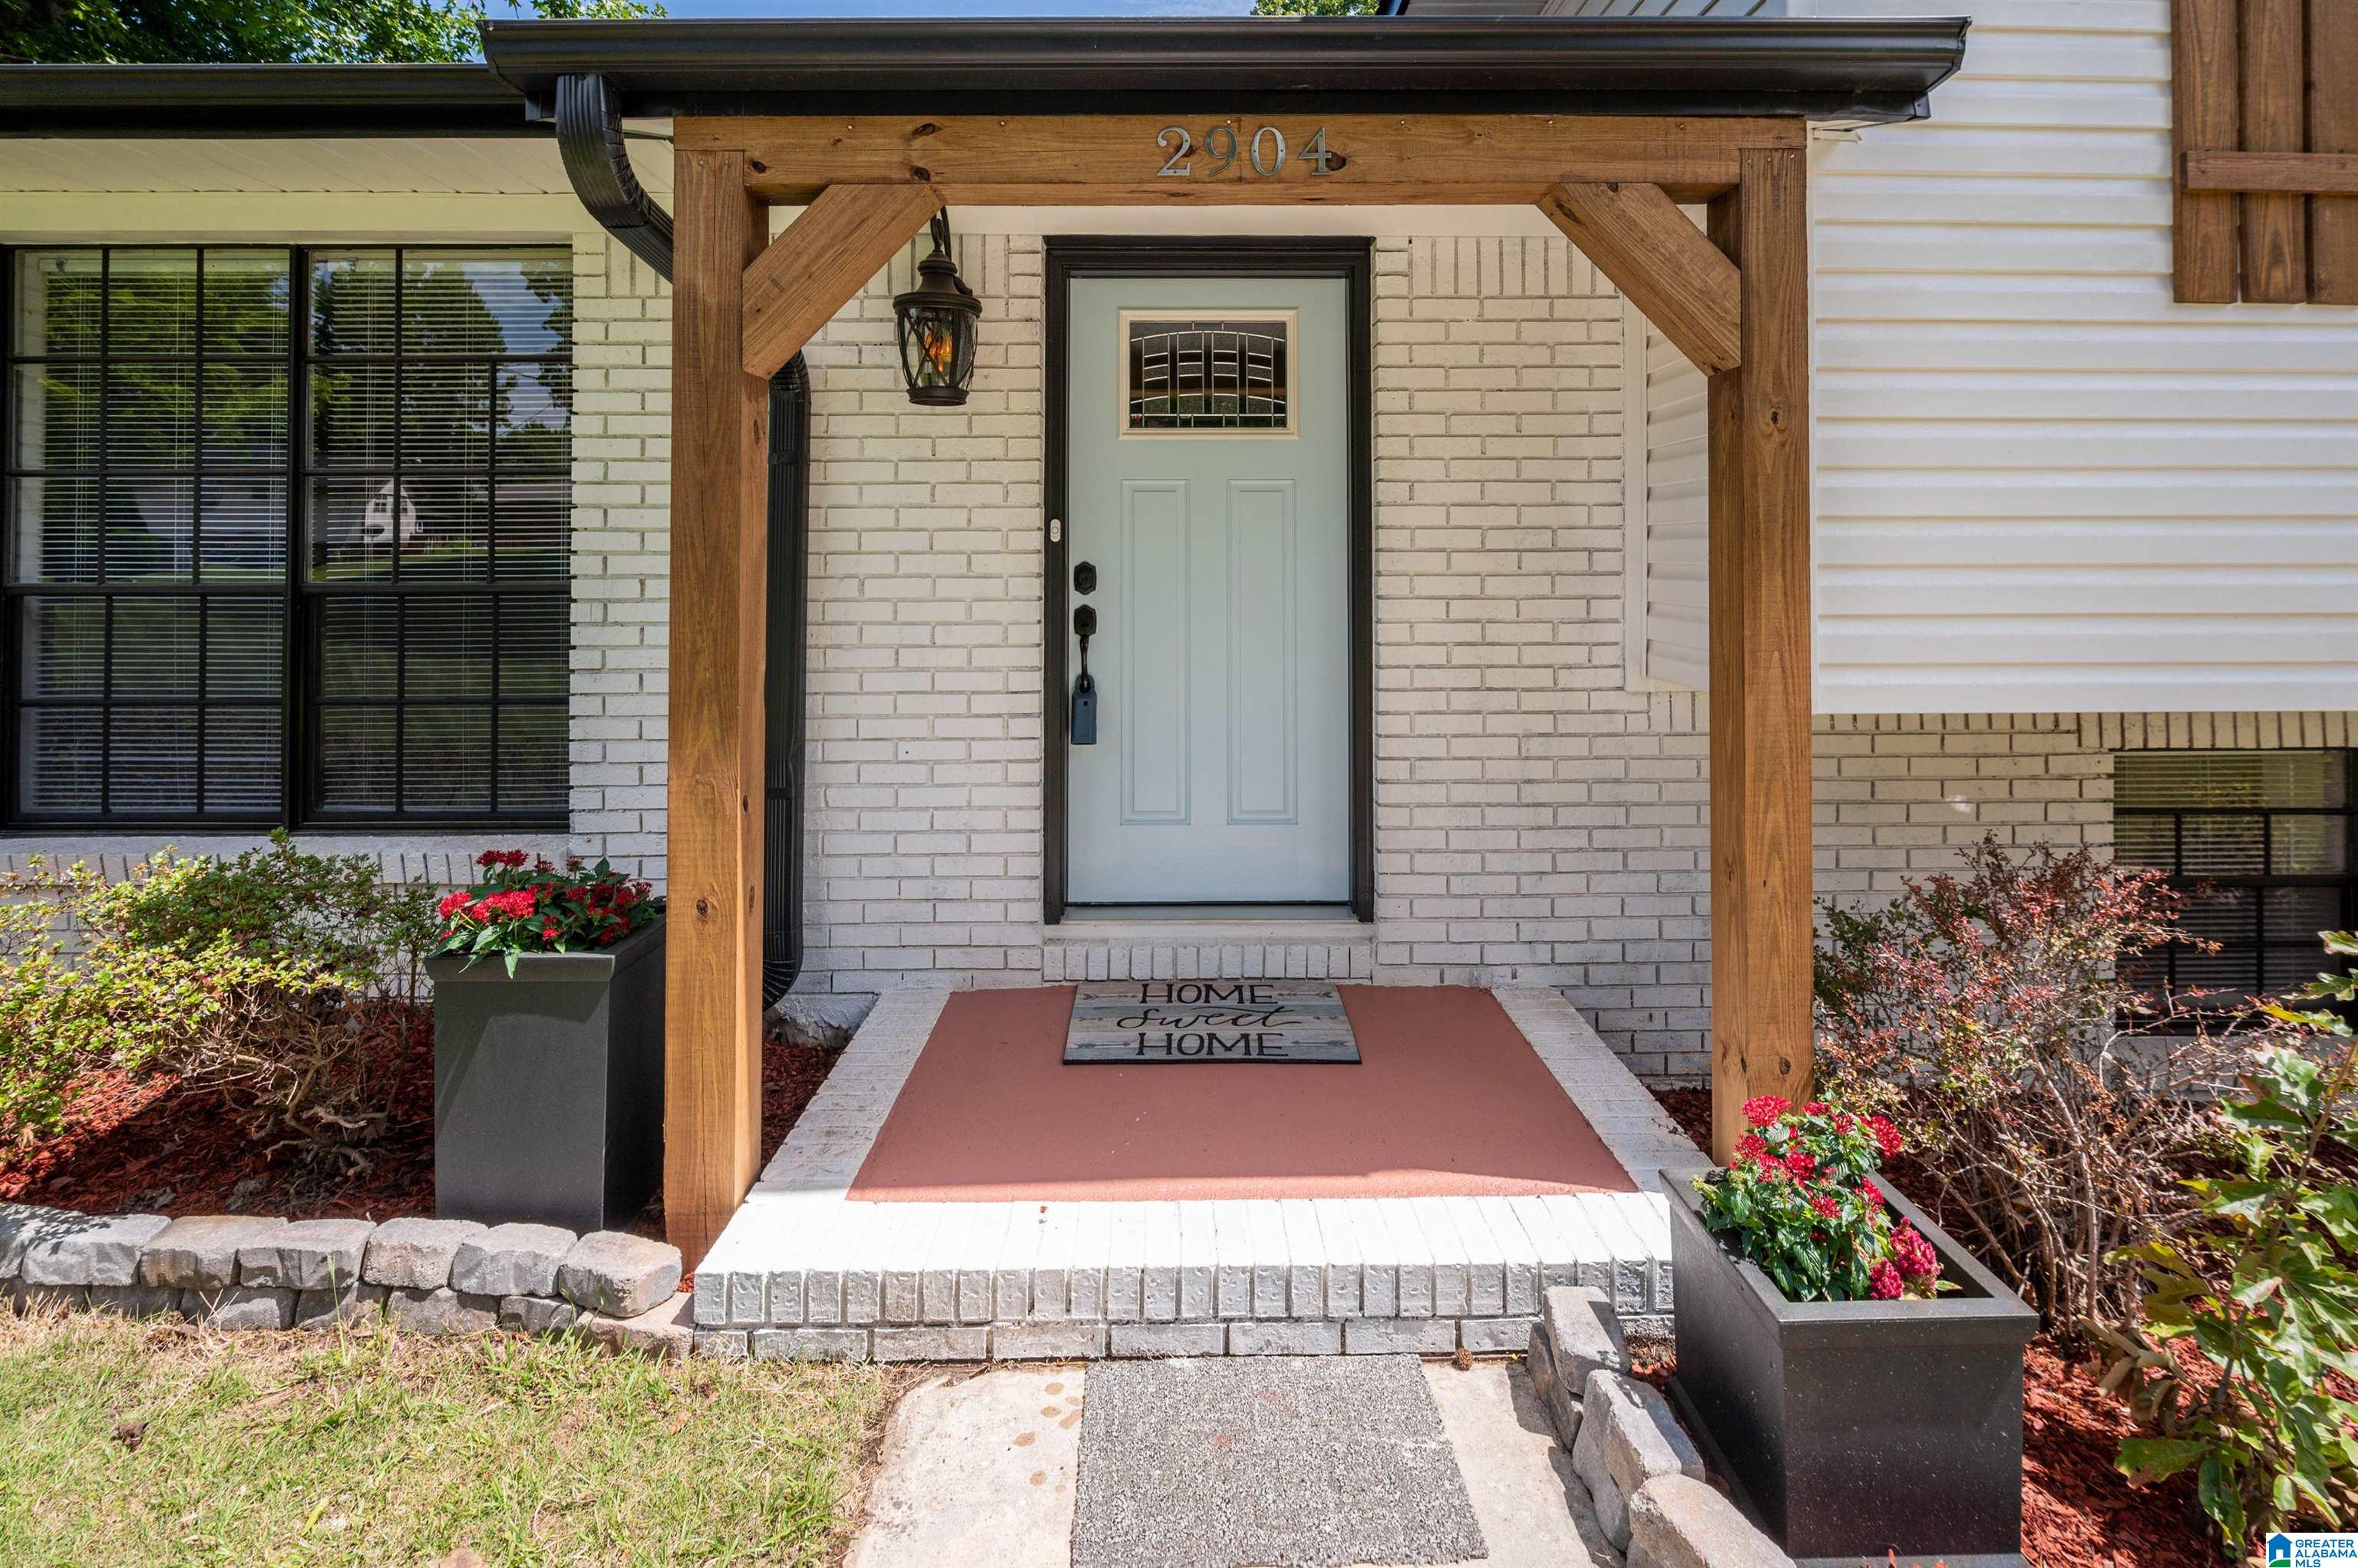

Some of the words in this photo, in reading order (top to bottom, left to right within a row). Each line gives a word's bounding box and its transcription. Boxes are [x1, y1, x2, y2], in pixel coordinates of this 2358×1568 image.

[1156, 126, 1333, 177] 2904
[1138, 983, 1279, 1005] HOME
[1135, 1032, 1290, 1057] HOME
